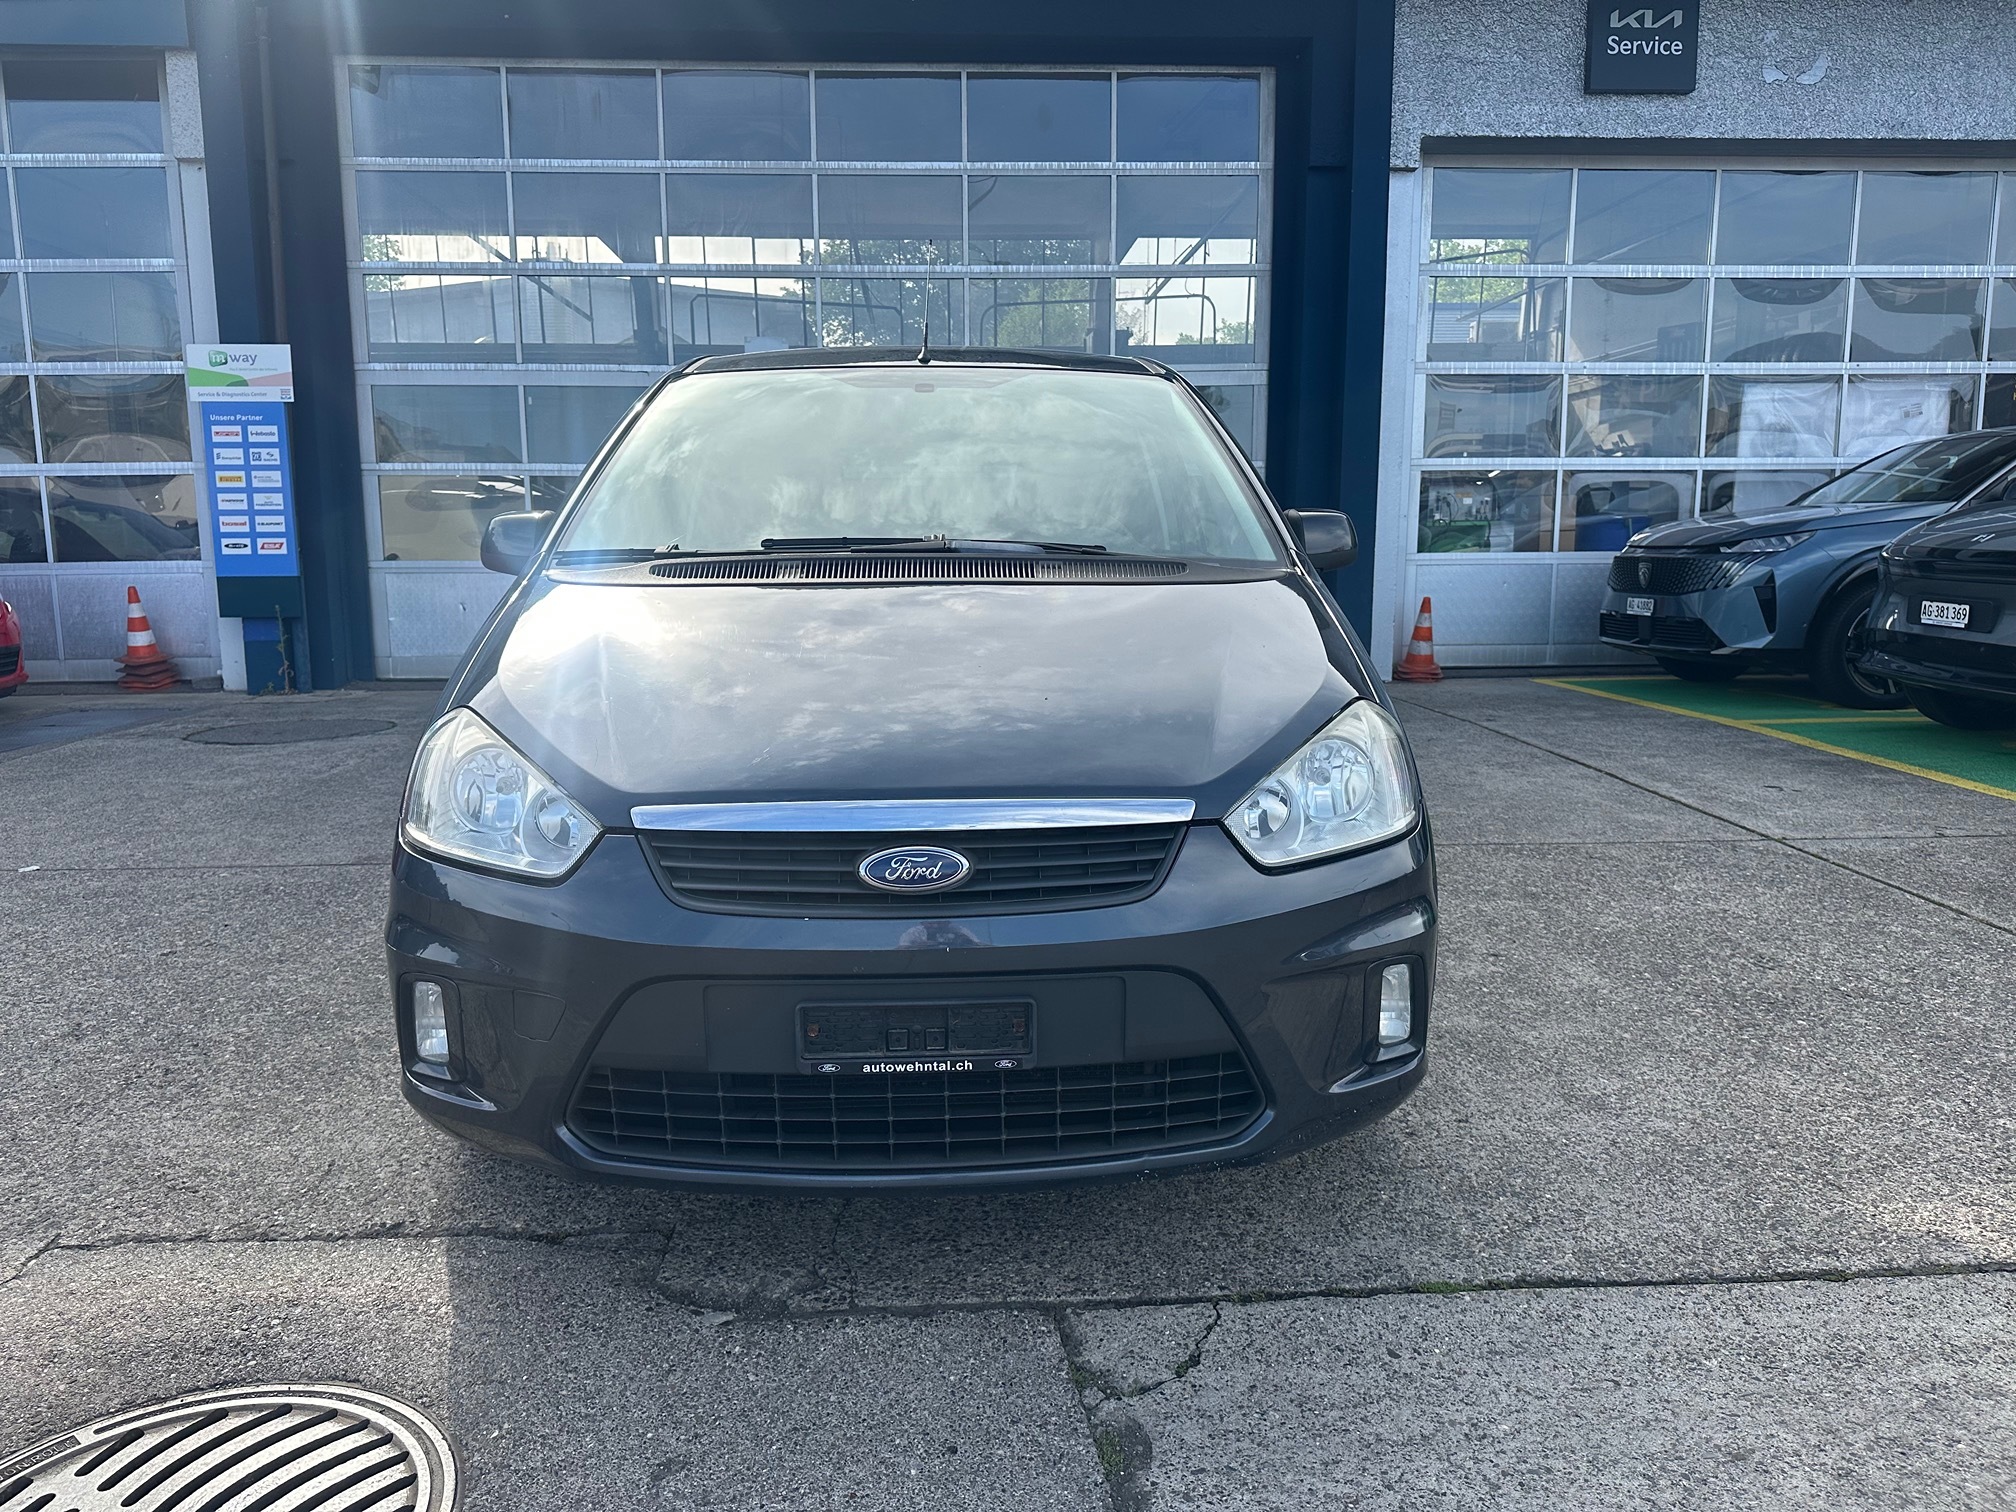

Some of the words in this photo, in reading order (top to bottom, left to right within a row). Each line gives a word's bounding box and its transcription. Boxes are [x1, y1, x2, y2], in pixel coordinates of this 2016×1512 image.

[1607, 35, 1683, 55] Service
[885, 856, 943, 881] Ford
[862, 1060, 973, 1073] autowehntal.ch
